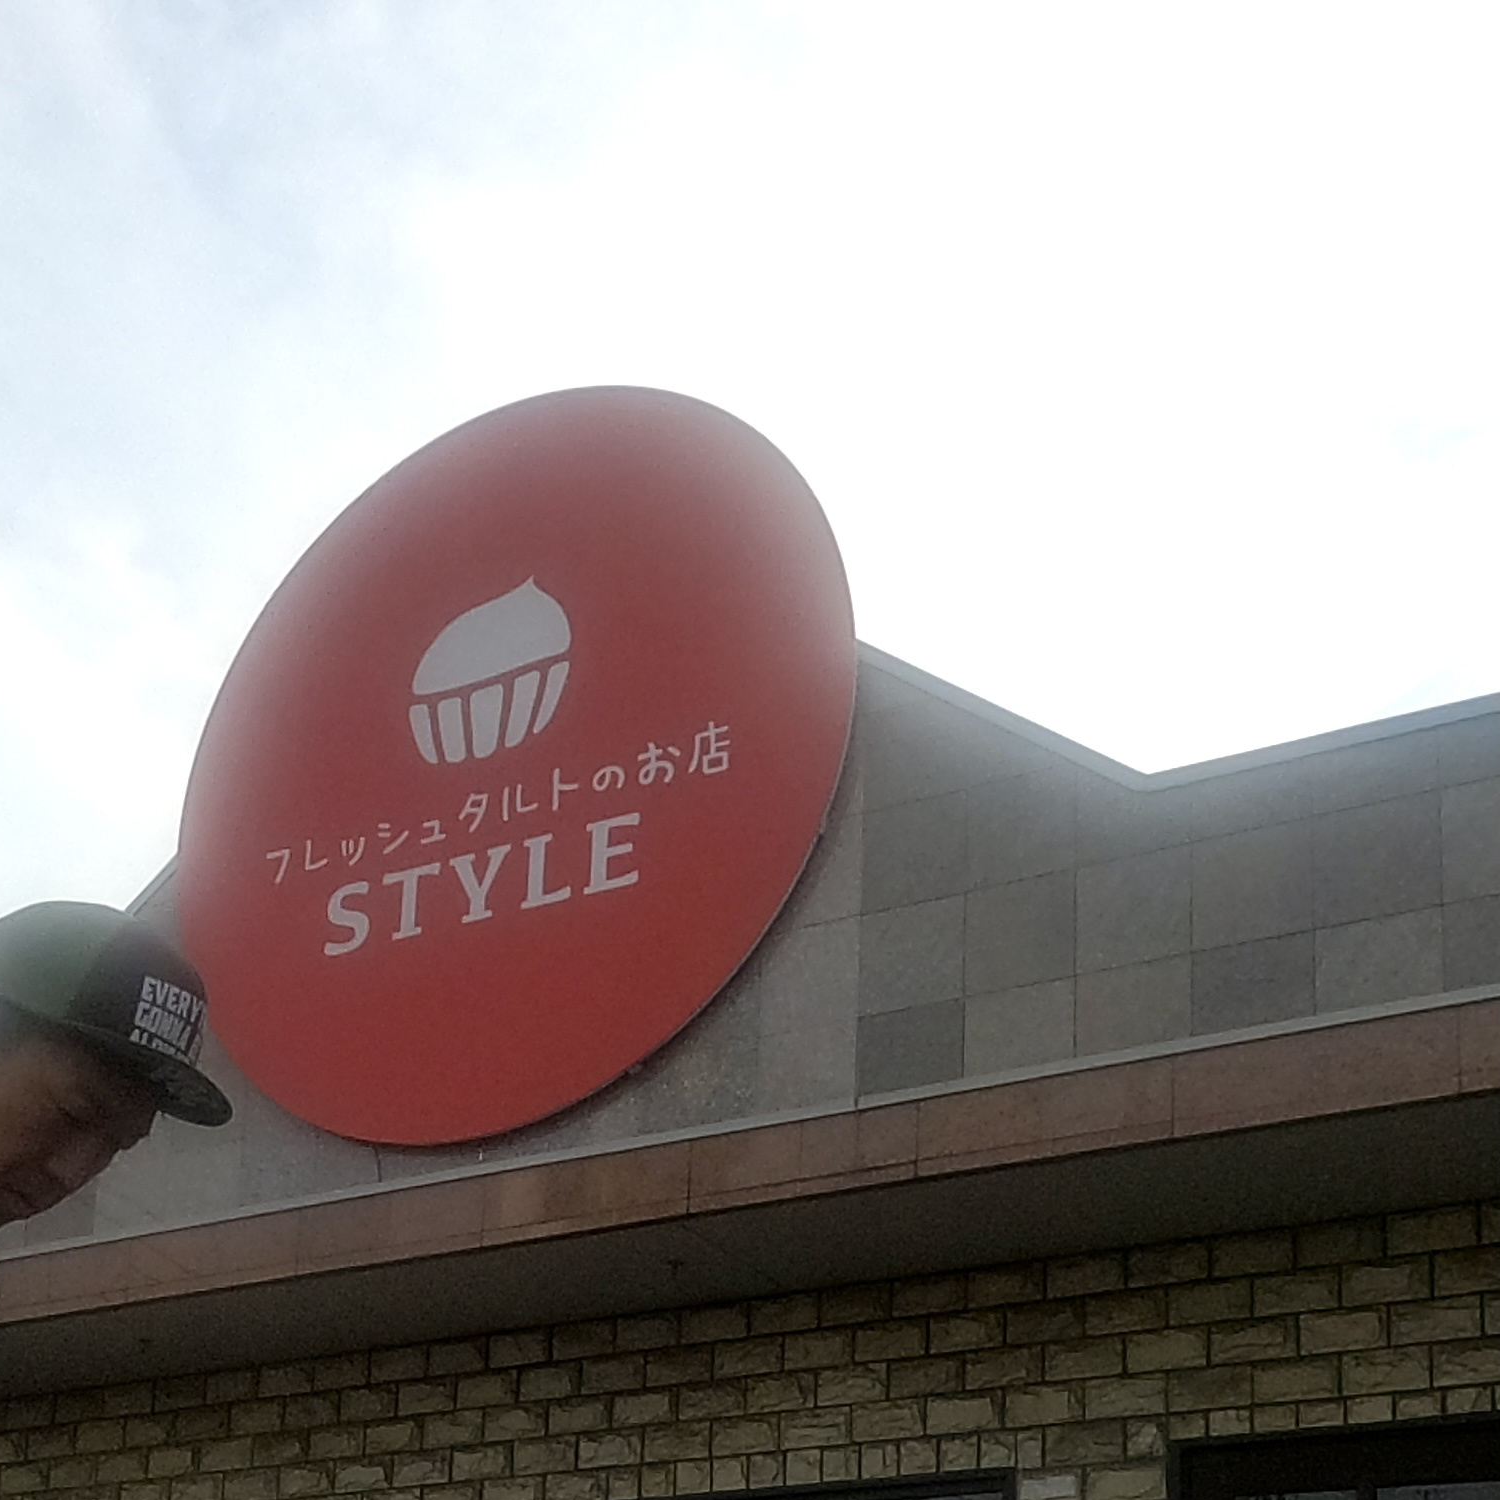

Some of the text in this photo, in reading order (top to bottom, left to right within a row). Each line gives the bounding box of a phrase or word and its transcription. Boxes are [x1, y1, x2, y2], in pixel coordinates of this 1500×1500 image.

[266, 721, 731, 885] フレッシュタルトのお店
[324, 812, 641, 956] STYLE
